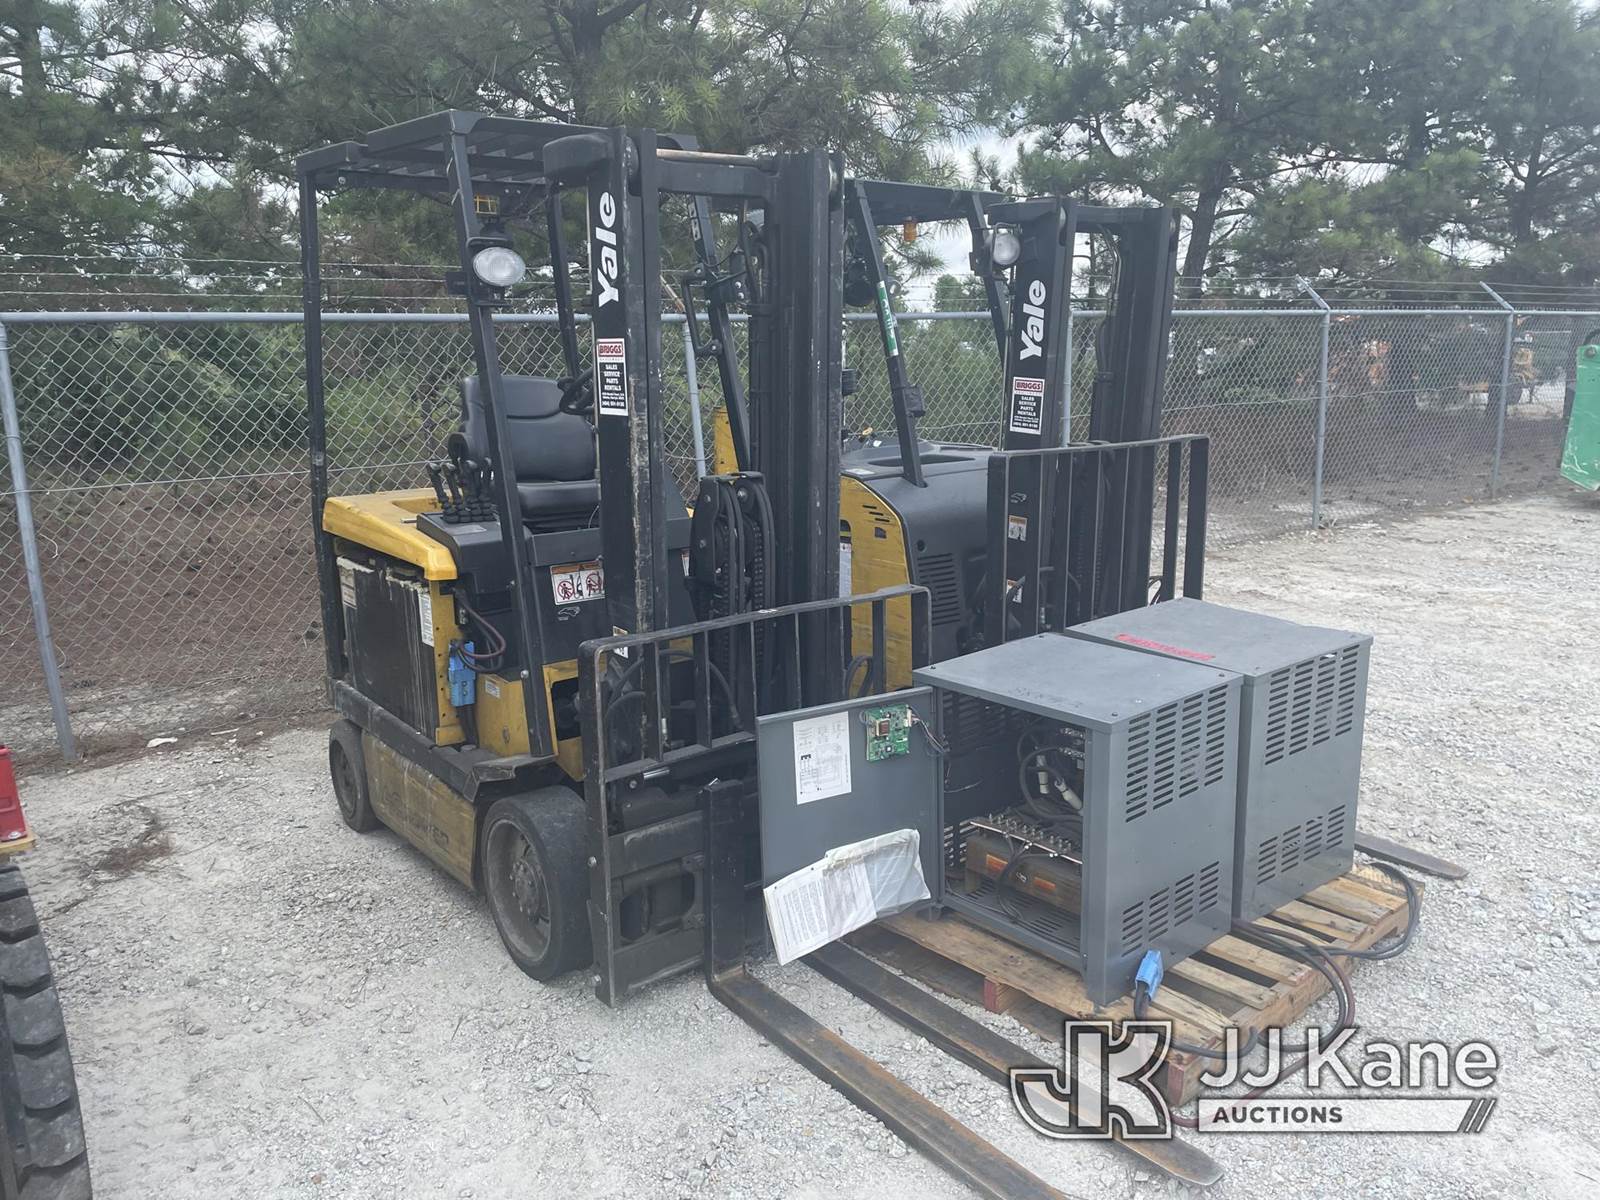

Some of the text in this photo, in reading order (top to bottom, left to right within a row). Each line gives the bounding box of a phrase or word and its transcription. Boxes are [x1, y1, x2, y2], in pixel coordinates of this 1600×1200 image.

[595, 191, 620, 308] Yale
[600, 345, 622, 354] BRIGGS
[1019, 279, 1047, 361] Yale
